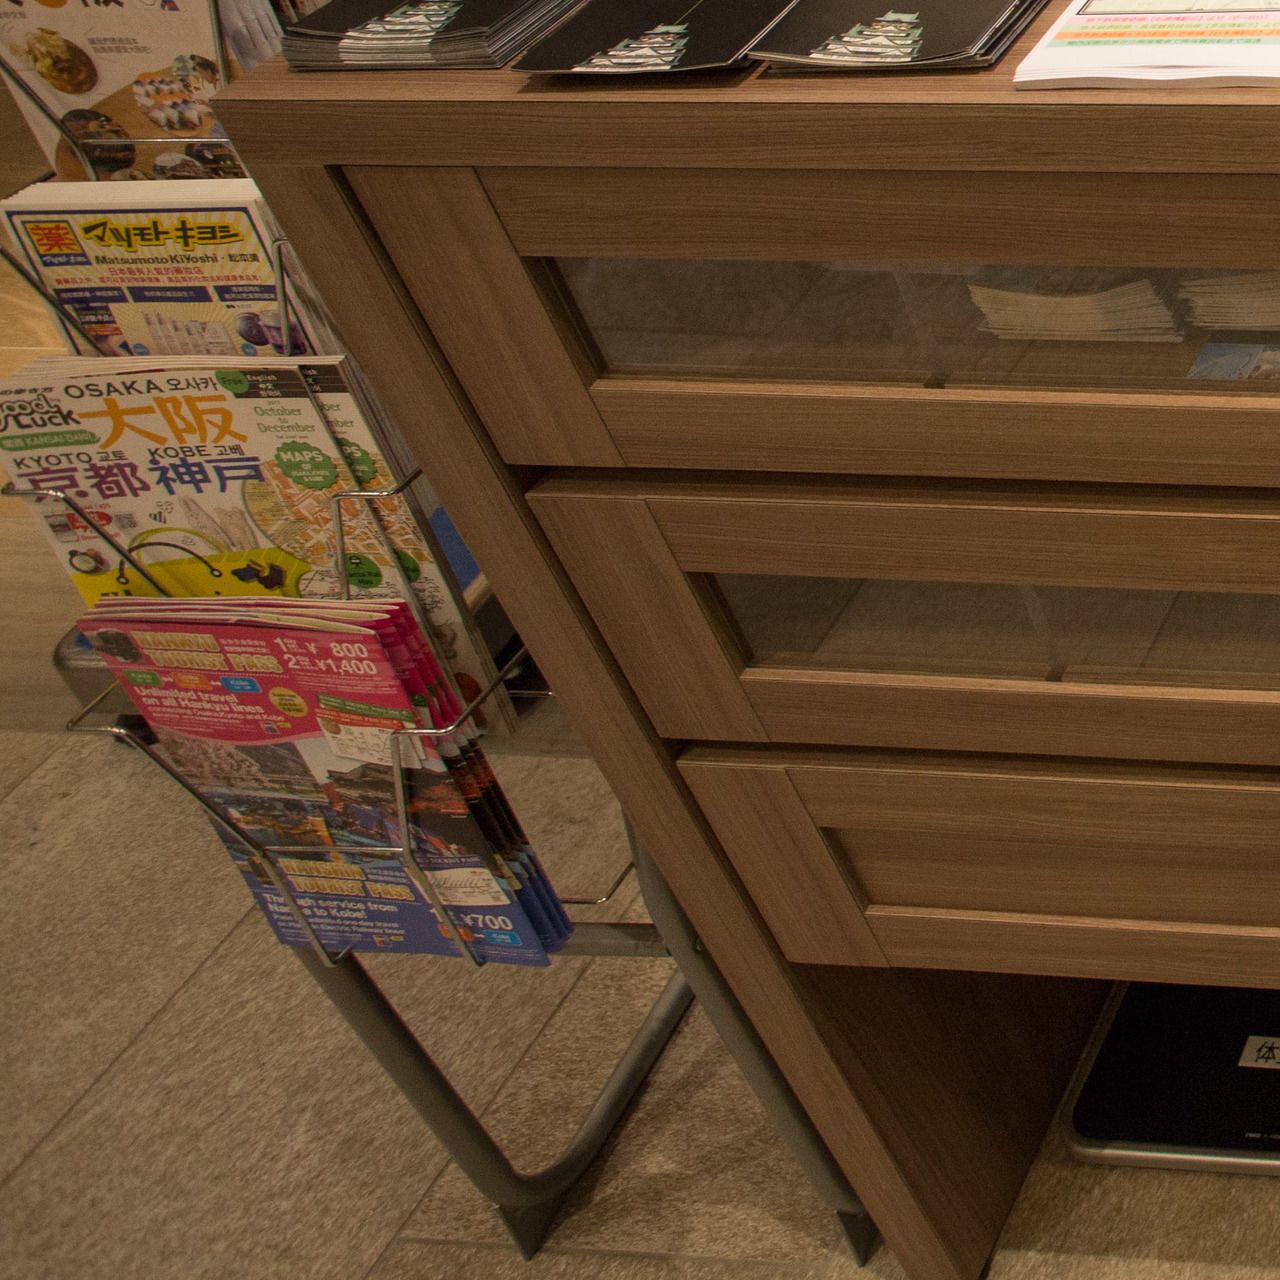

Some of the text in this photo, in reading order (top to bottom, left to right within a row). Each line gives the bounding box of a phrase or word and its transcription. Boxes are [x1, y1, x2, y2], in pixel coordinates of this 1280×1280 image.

[82, 220, 242, 250] マツモトキヨシ
[95, 254, 168, 265] Matsumoto
[170, 253, 218, 265] KiYoshi
[64, 376, 219, 399] OSAKA 오사카
[254, 406, 303, 417] October
[77, 393, 250, 448] 大阪
[256, 422, 316, 433] December
[14, 450, 128, 470] KYOTO 교토
[148, 444, 245, 459] KOBE 고베
[279, 450, 324, 463] MAPS
[17, 462, 151, 503] 京都
[147, 456, 266, 496] 神戸
[331, 642, 369, 658] 800
[318, 658, 377, 675] ¥1,400
[134, 685, 238, 703] Unlimited travel
[231, 702, 265, 713] lines
